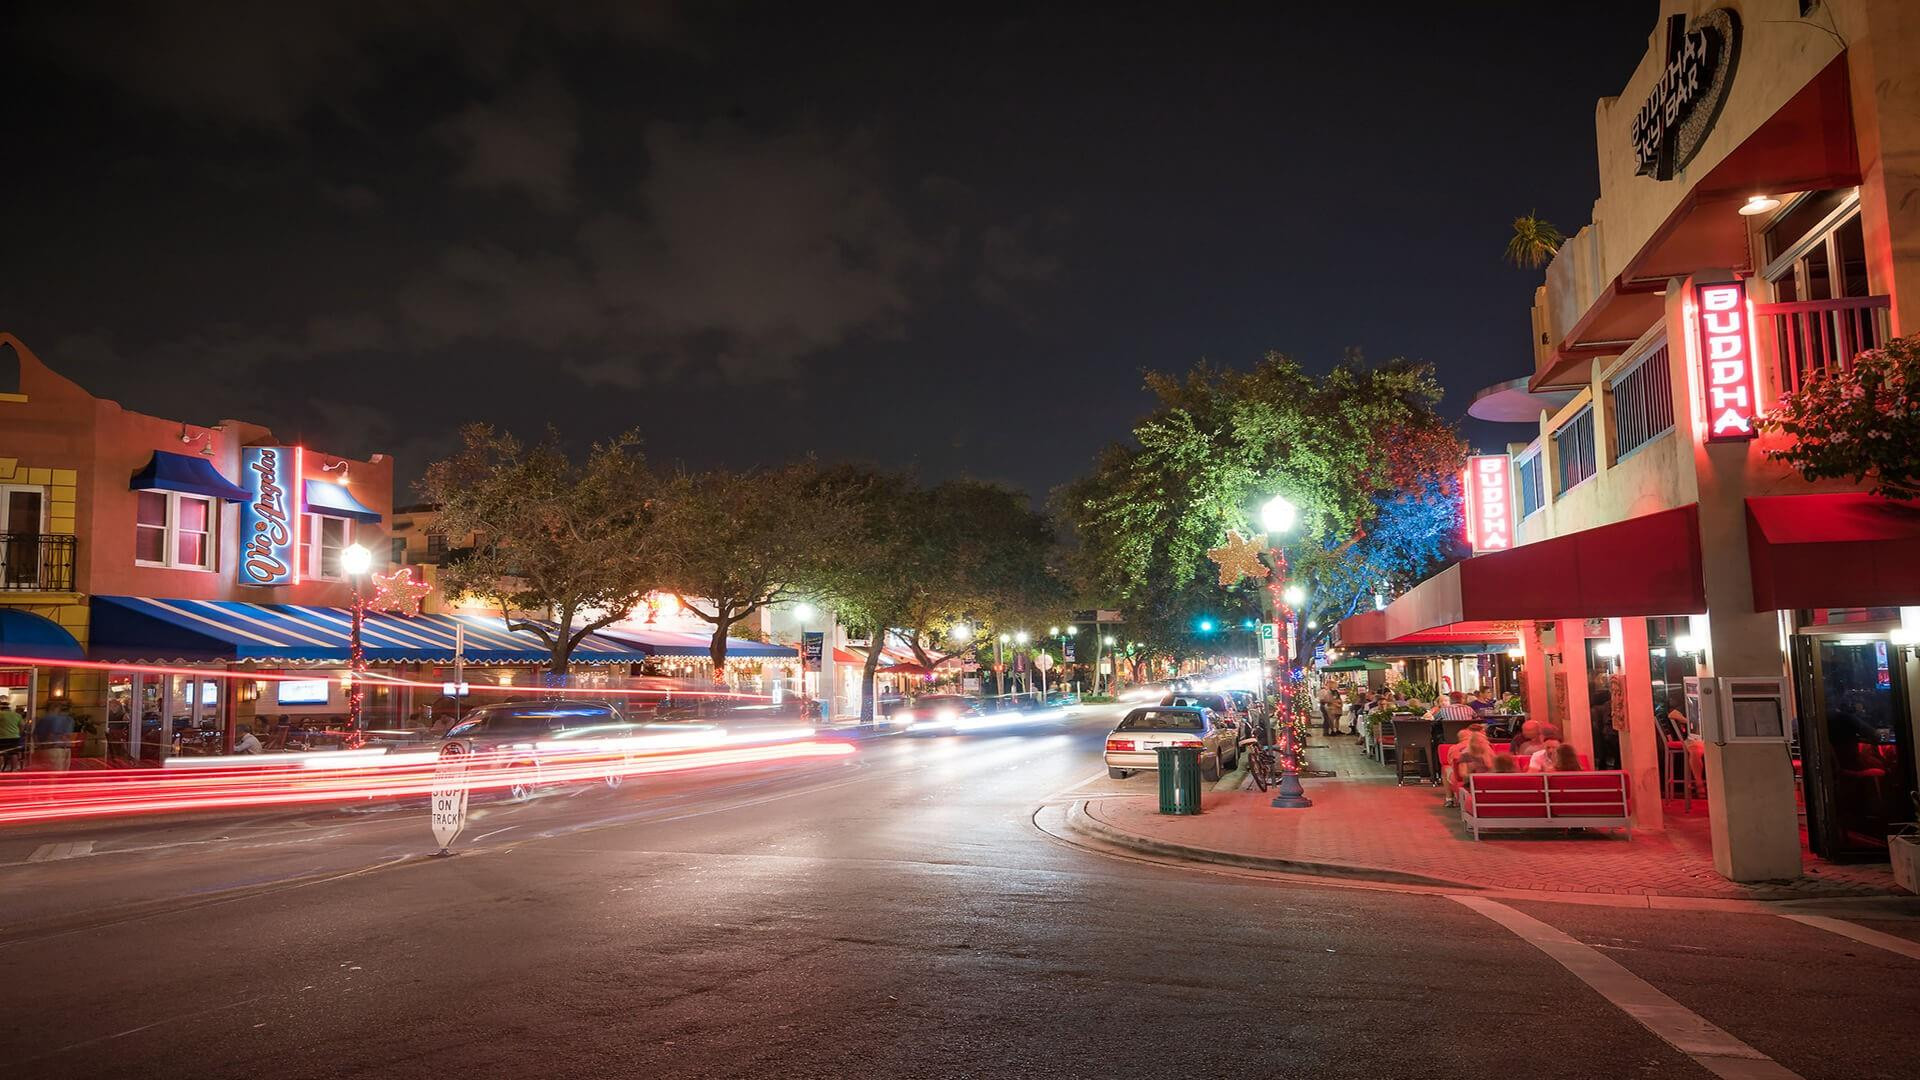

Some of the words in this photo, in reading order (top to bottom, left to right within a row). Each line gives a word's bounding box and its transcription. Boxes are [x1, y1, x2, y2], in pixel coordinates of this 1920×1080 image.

[1632, 33, 1697, 146] BUDDHA
[1634, 115, 1660, 175] SKY
[1666, 62, 1699, 128] BAR
[1702, 288, 1750, 434] BUDDHA
[251, 449, 289, 546] Angelos
[1479, 458, 1507, 548] BUDDHA
[1264, 627, 1272, 637] 2
[432, 813, 458, 825] TRACK
[438, 799, 452, 811] ON
